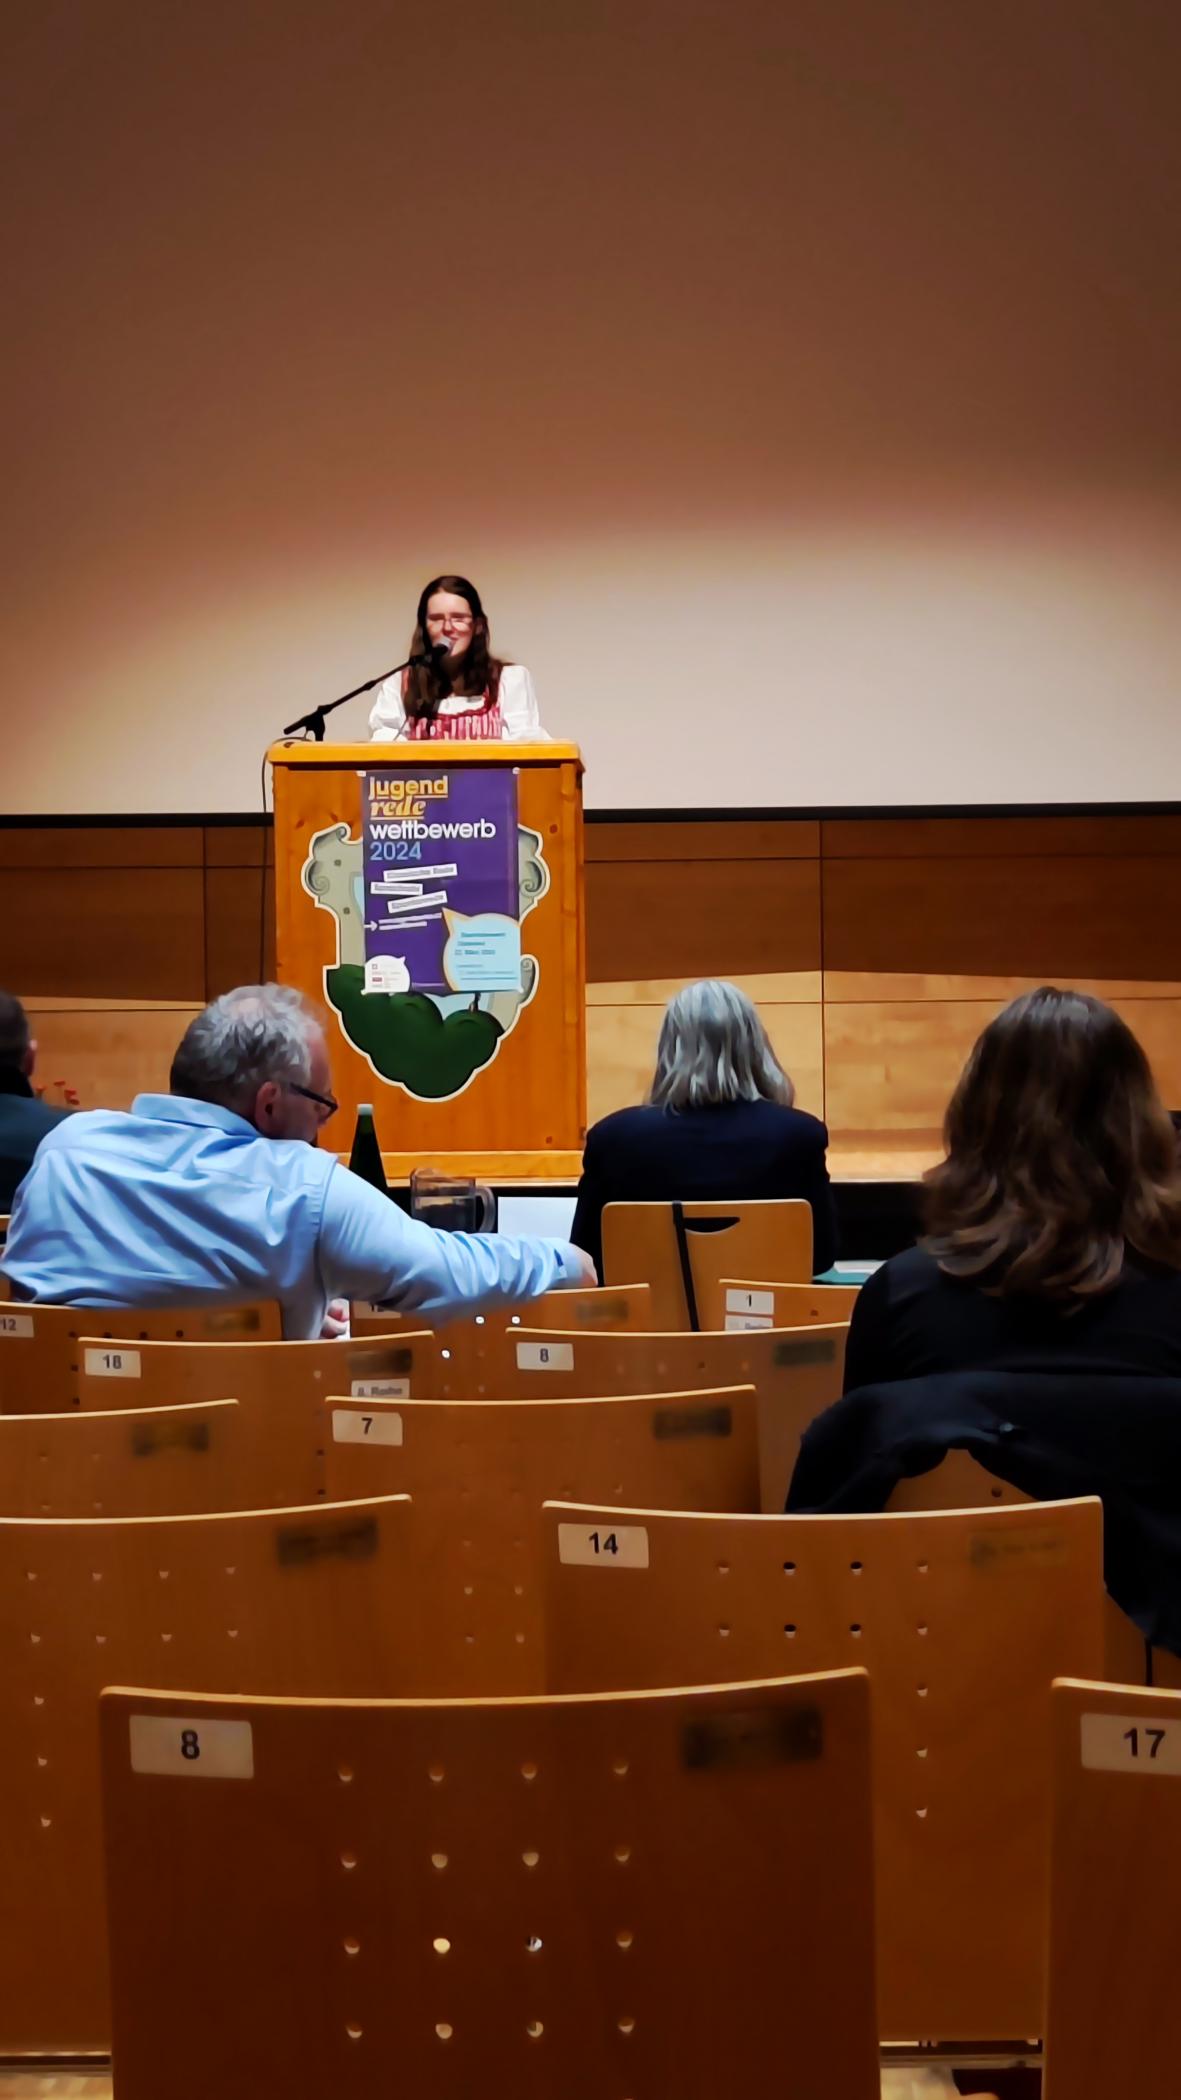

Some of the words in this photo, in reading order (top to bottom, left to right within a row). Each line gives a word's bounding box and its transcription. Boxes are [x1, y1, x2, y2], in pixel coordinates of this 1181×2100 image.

[371, 795, 426, 816] rede
[369, 819, 496, 839] wettbewerb
[370, 841, 422, 860] 2024
[0, 1318, 17, 1331] 12
[102, 1354, 122, 1369] 18
[540, 1348, 549, 1362] 8
[361, 1417, 373, 1434] 7
[589, 1532, 618, 1554] 14
[181, 1730, 200, 1760] 8
[1123, 1727, 1166, 1758] 17
